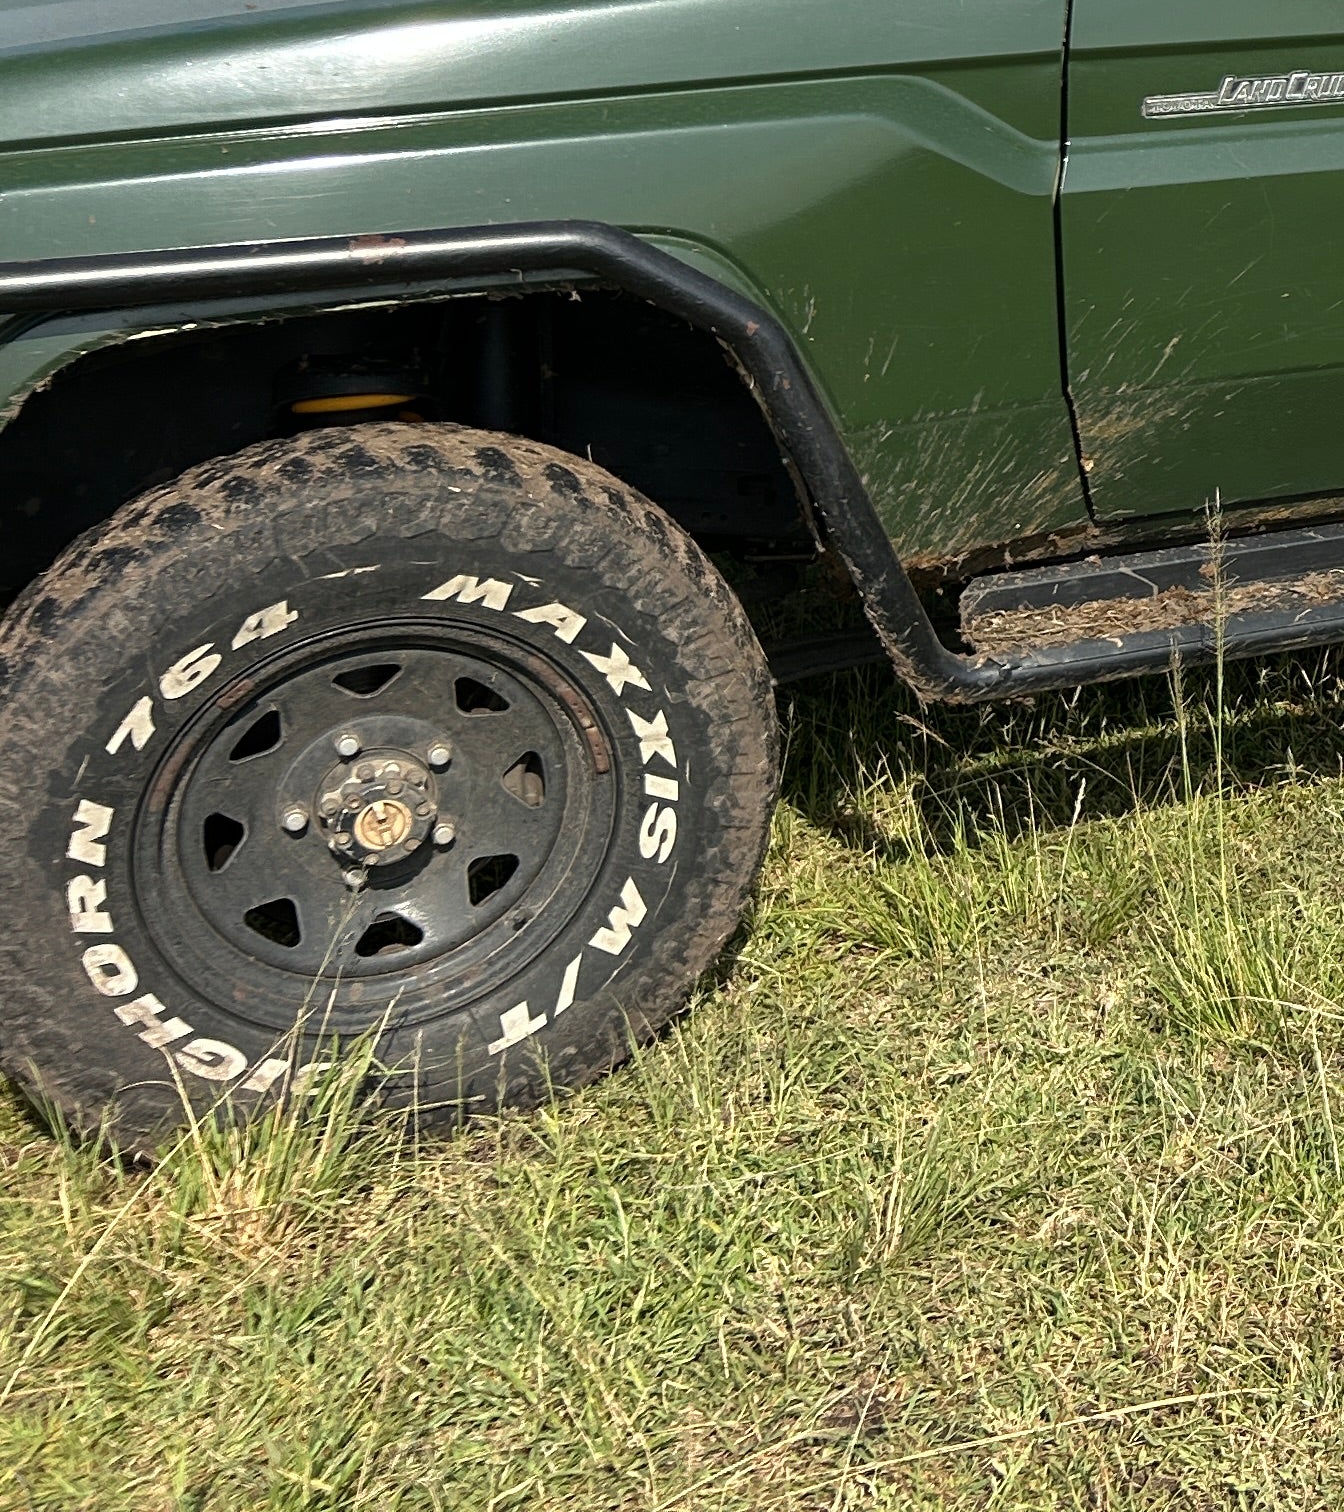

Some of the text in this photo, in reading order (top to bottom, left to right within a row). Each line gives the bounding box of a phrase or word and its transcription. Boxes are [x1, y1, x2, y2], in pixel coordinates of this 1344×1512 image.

[105, 599, 300, 755] 764
[420, 574, 680, 1057] MAXXIS M/T
